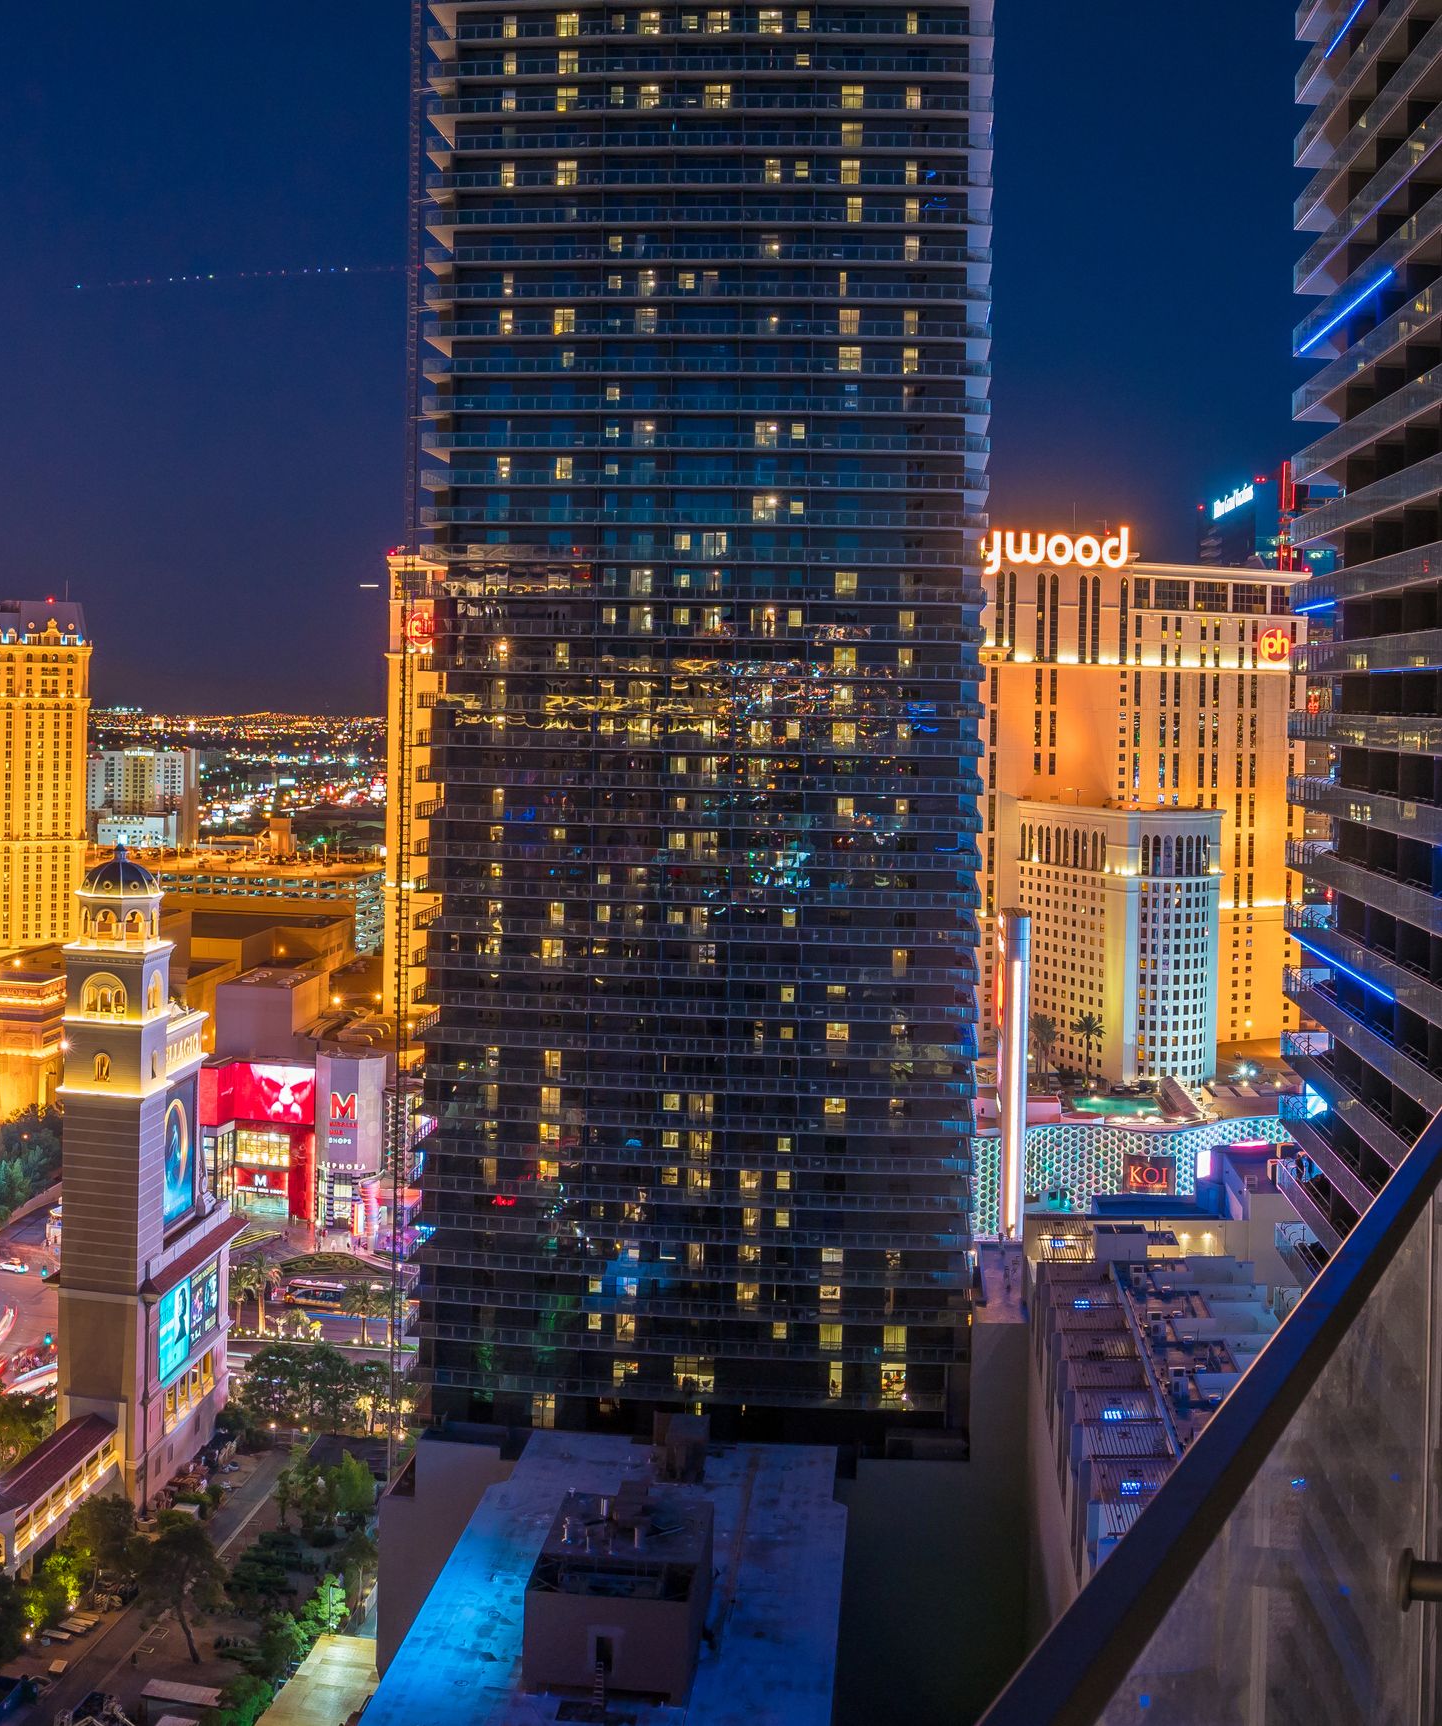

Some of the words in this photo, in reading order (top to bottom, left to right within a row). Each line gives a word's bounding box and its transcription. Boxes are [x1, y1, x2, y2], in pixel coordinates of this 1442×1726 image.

[329, 1091, 358, 1120] M
[328, 1137, 352, 1145] SHOPS
[321, 1160, 366, 1170] SEPHORA
[254, 1174, 267, 1187] M
[1129, 1164, 1168, 1184] KOI
